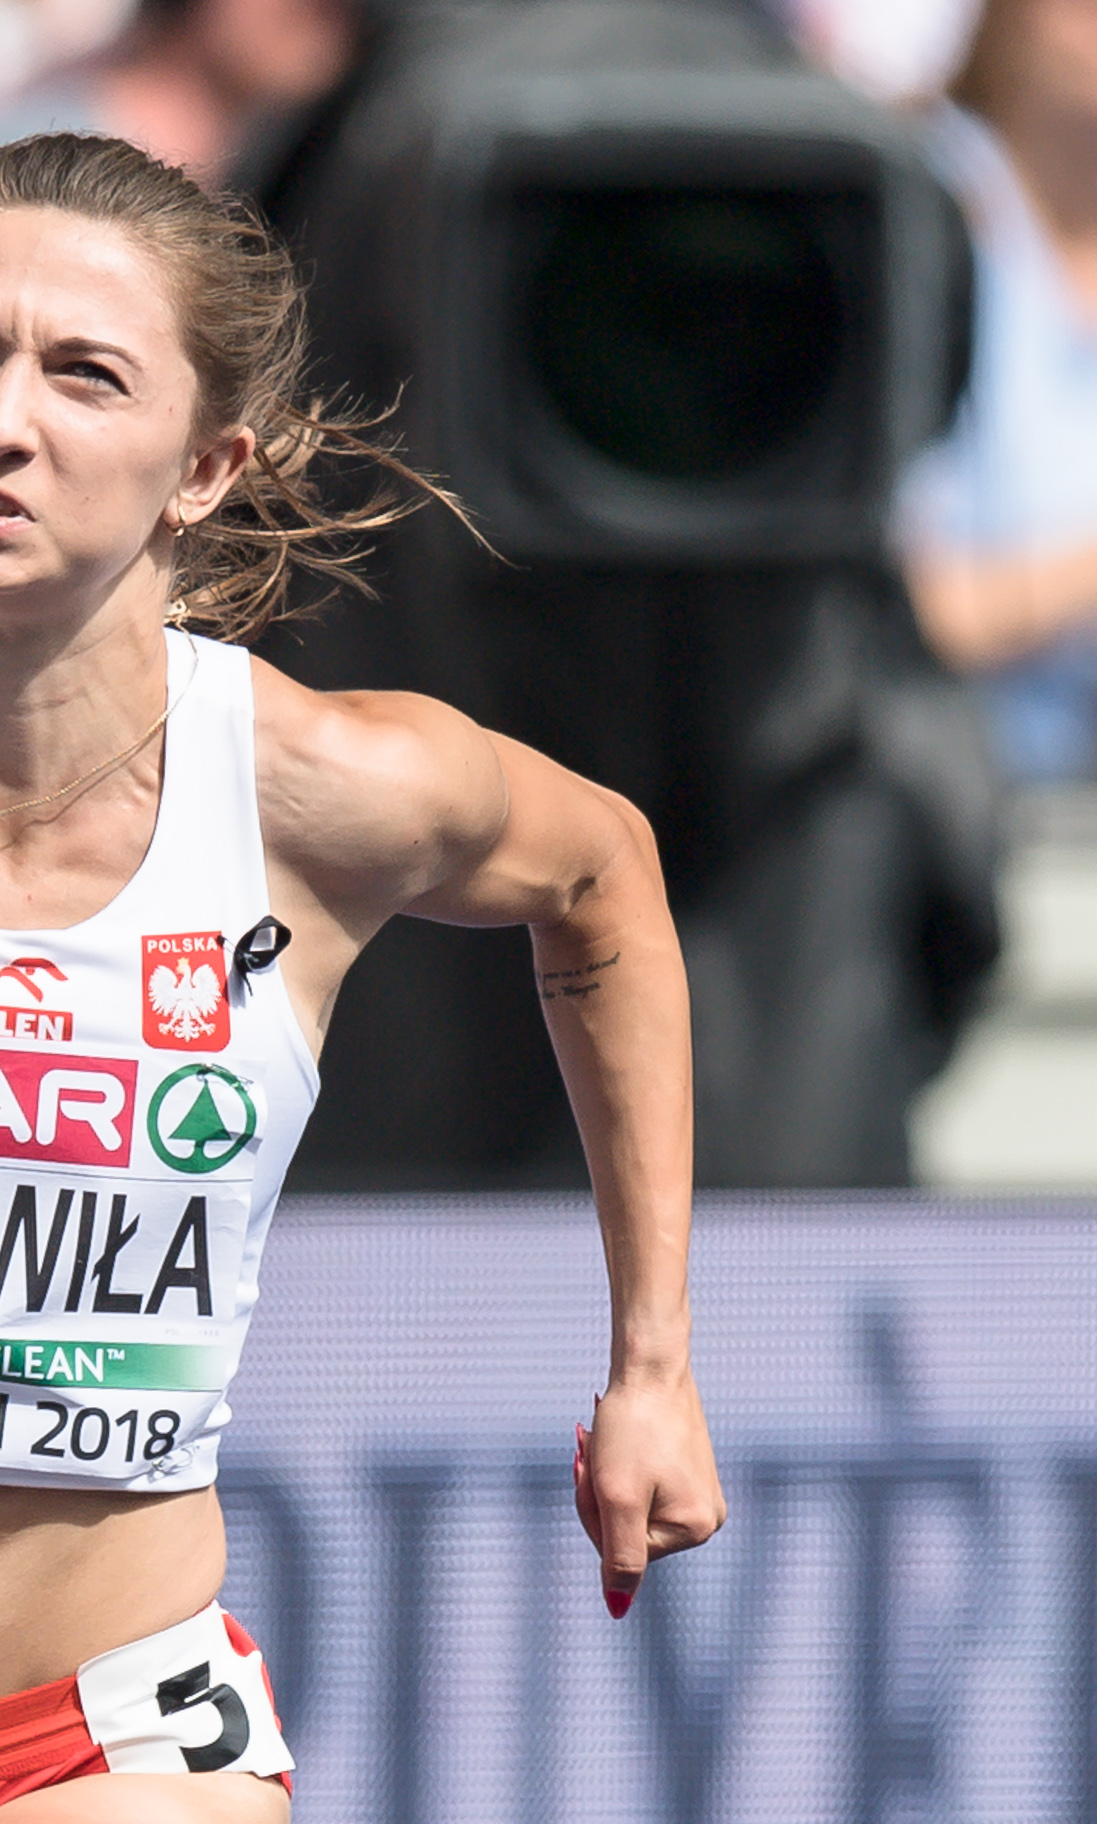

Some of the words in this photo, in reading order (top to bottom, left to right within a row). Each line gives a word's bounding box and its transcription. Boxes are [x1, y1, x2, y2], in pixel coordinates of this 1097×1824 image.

[147, 937, 218, 954] POLSKA
[30, 1400, 182, 1463] 2018
[155, 1659, 250, 1773] 5
